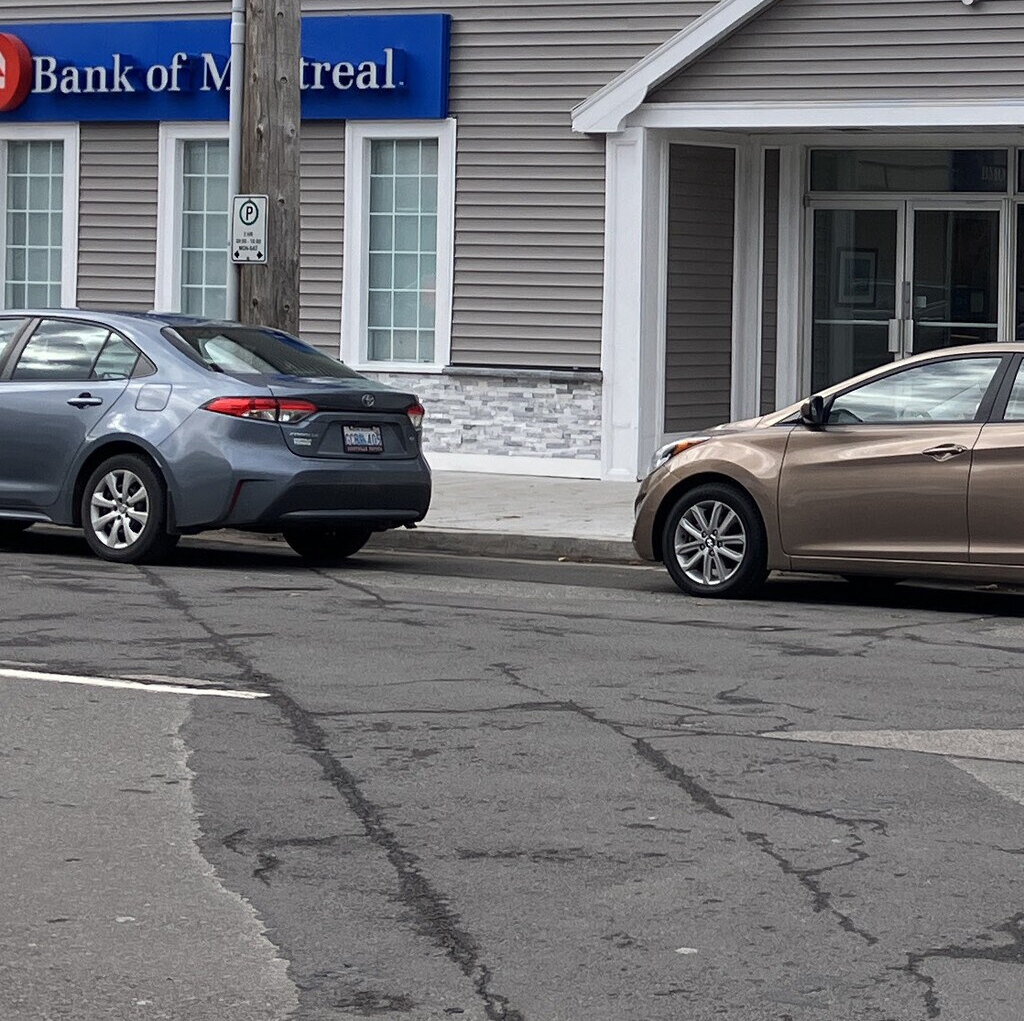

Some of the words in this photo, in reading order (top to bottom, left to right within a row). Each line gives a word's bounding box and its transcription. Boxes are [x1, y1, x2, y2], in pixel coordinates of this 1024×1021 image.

[31, 53, 136, 94] Bank
[146, 52, 188, 92] of
[200, 47, 396, 91] Mtreal
